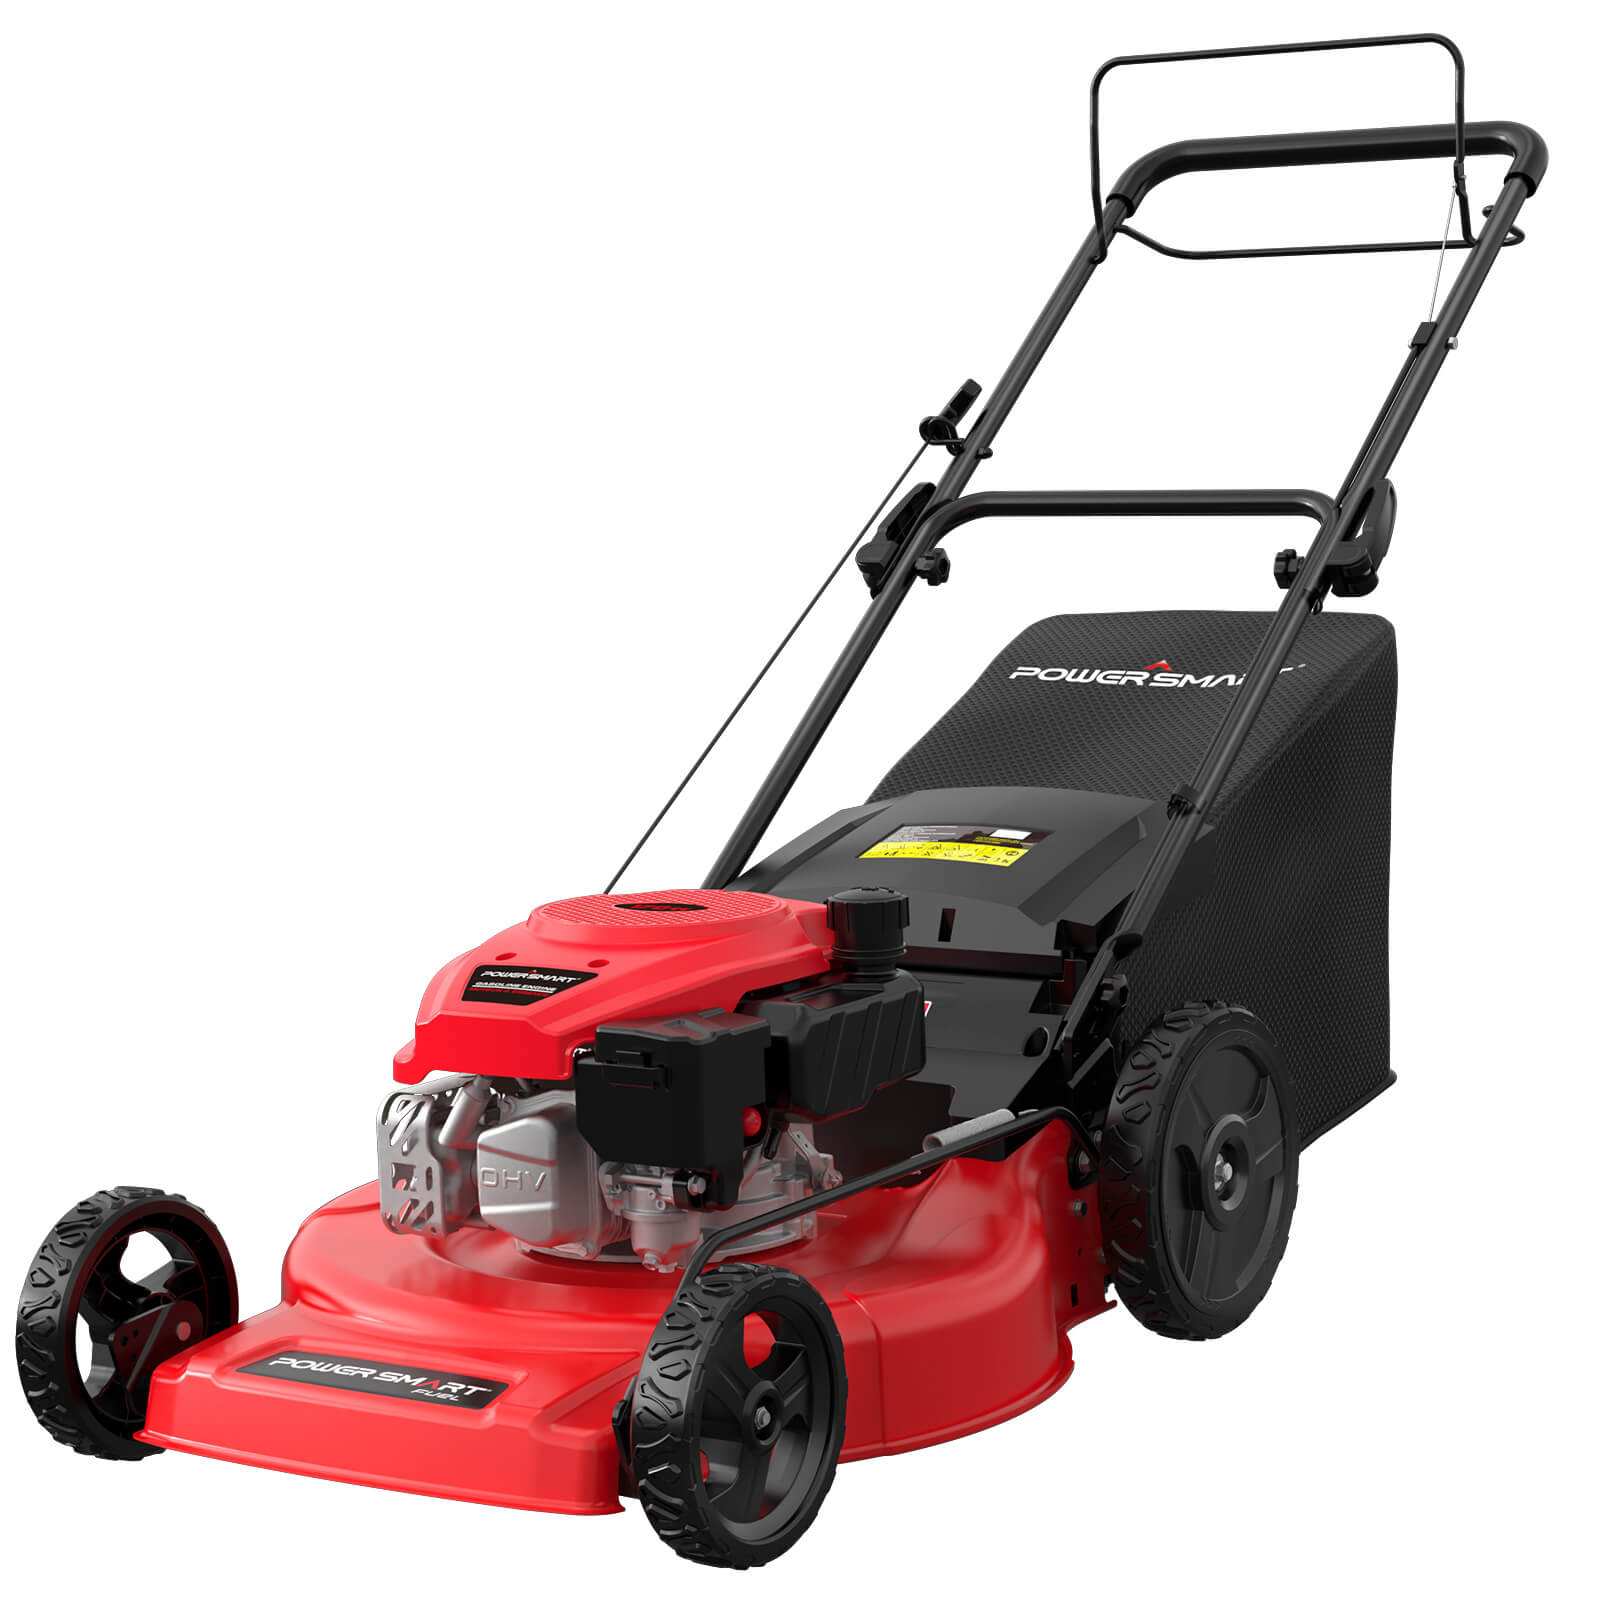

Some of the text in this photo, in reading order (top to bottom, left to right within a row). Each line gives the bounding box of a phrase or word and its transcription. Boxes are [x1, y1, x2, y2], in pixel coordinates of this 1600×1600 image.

[480, 1167, 547, 1192] OHV
[268, 1357, 377, 1379] POWER
[410, 1388, 460, 1402] FUEL
